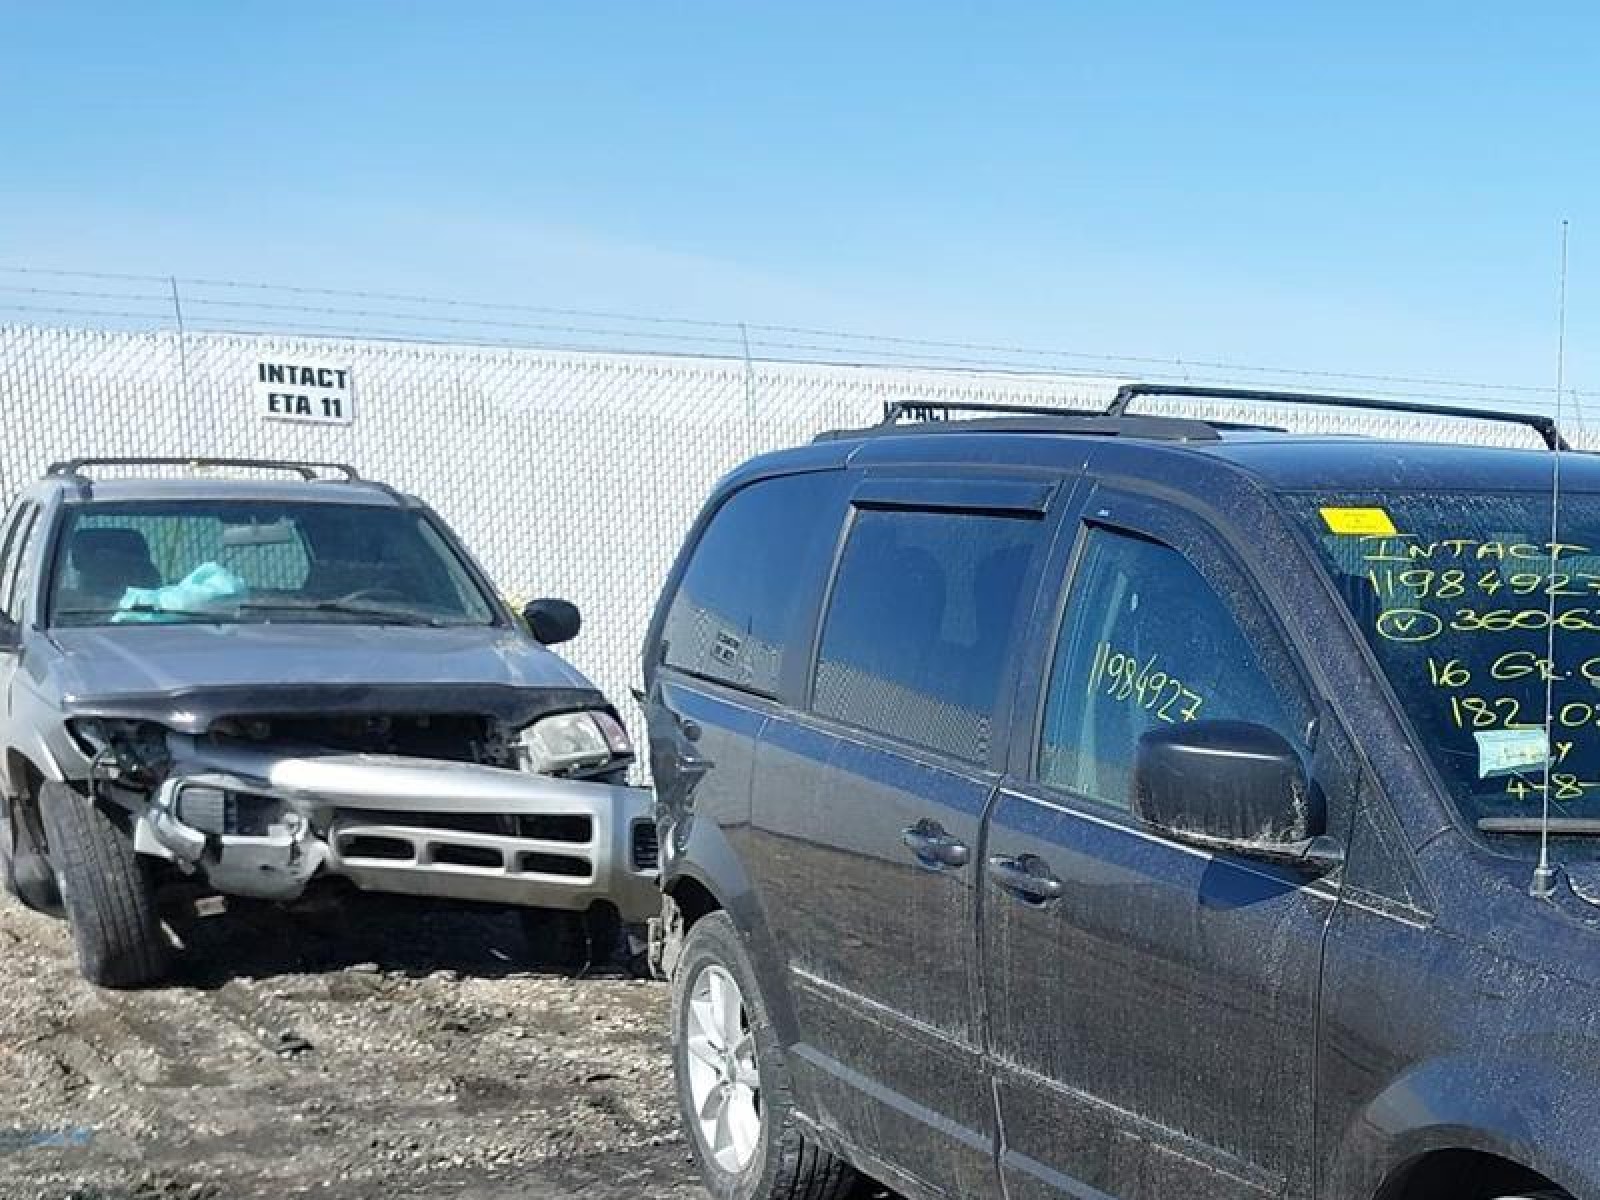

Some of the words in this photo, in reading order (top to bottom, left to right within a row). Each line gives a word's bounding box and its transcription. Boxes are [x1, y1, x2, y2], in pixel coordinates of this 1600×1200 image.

[258, 362, 347, 390] INTACT
[268, 392, 312, 416] ETA
[321, 397, 342, 418] 11
[1360, 534, 1590, 561] INTACT
[1087, 641, 1203, 724] 11984927
[1428, 656, 1471, 687] 16
